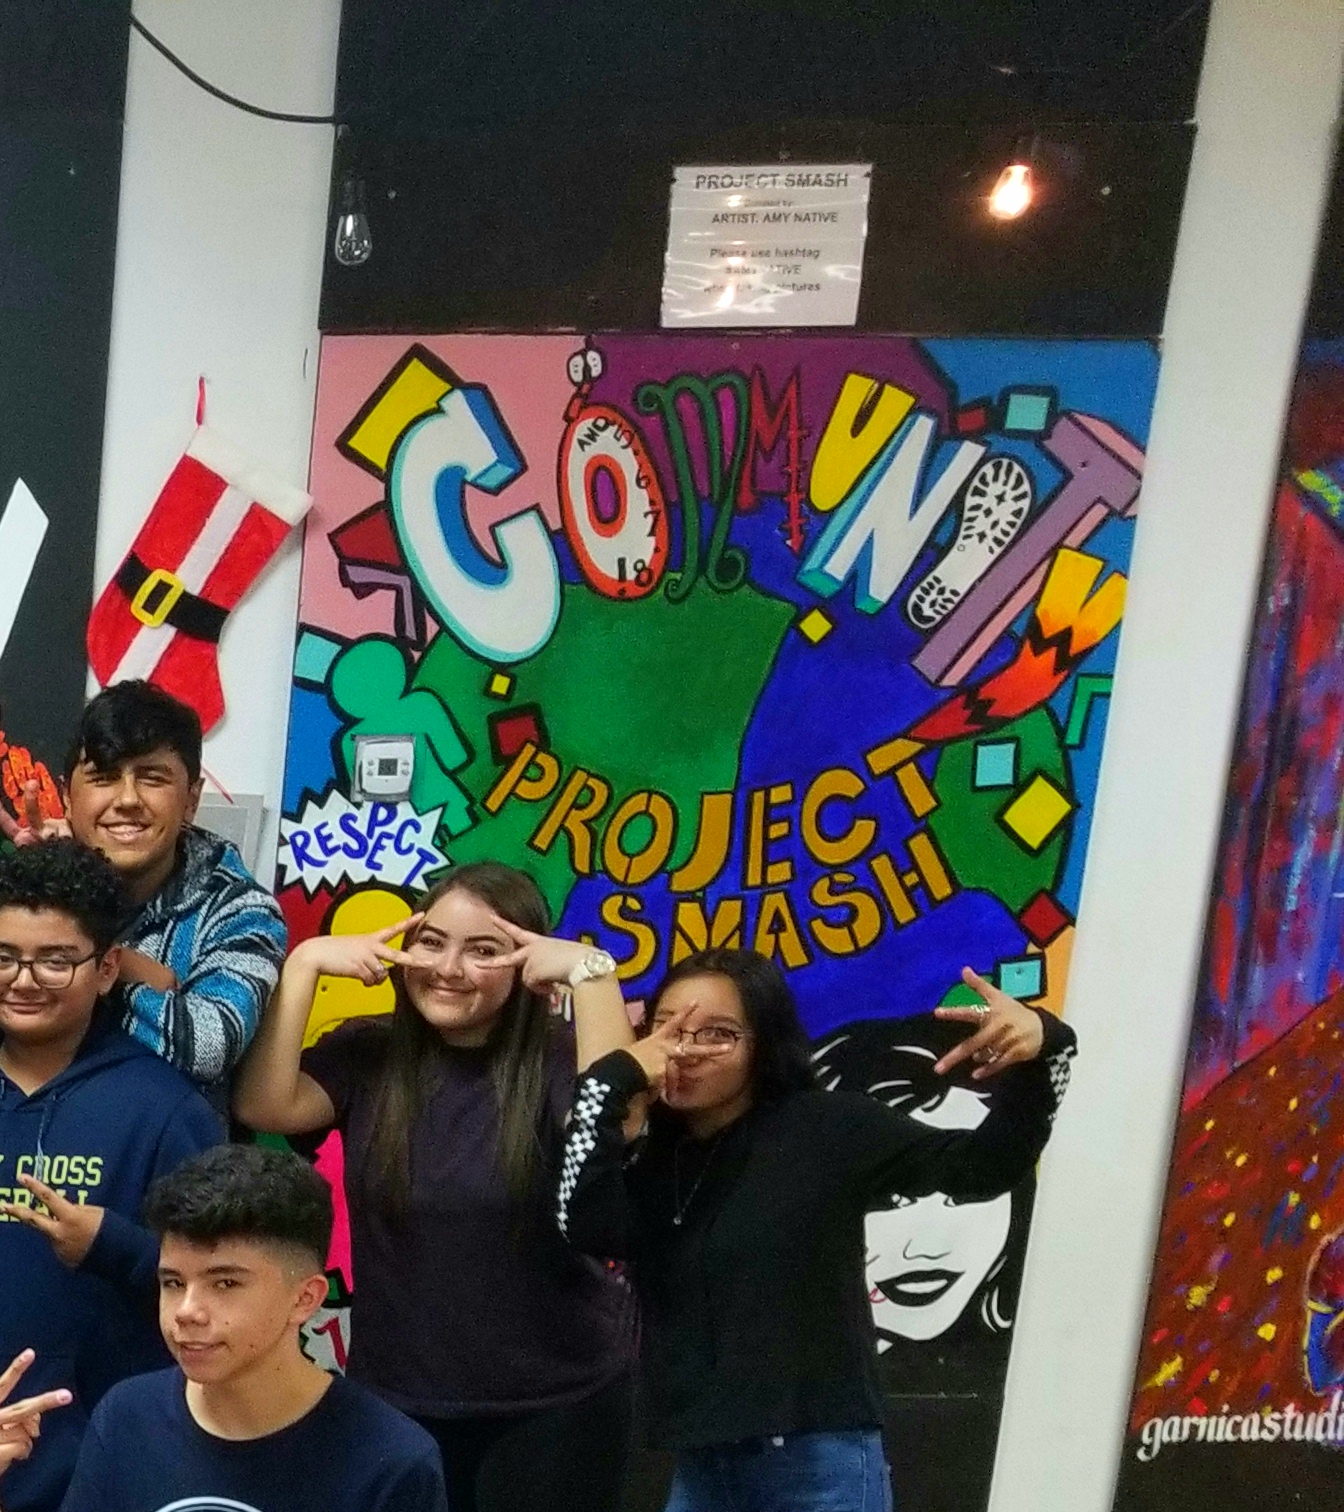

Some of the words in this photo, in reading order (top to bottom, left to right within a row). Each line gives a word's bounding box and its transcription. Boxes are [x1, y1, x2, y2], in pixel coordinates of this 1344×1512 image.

[695, 174, 780, 189] PROJECT
[784, 173, 848, 188] SMASH
[763, 212, 791, 223] AMY
[793, 212, 838, 223] NATIVE
[482, 736, 941, 893] PROJECT
[289, 801, 440, 888] RESPECT
[582, 830, 956, 981] SMASH
[16, 1155, 105, 1187] CROSS
